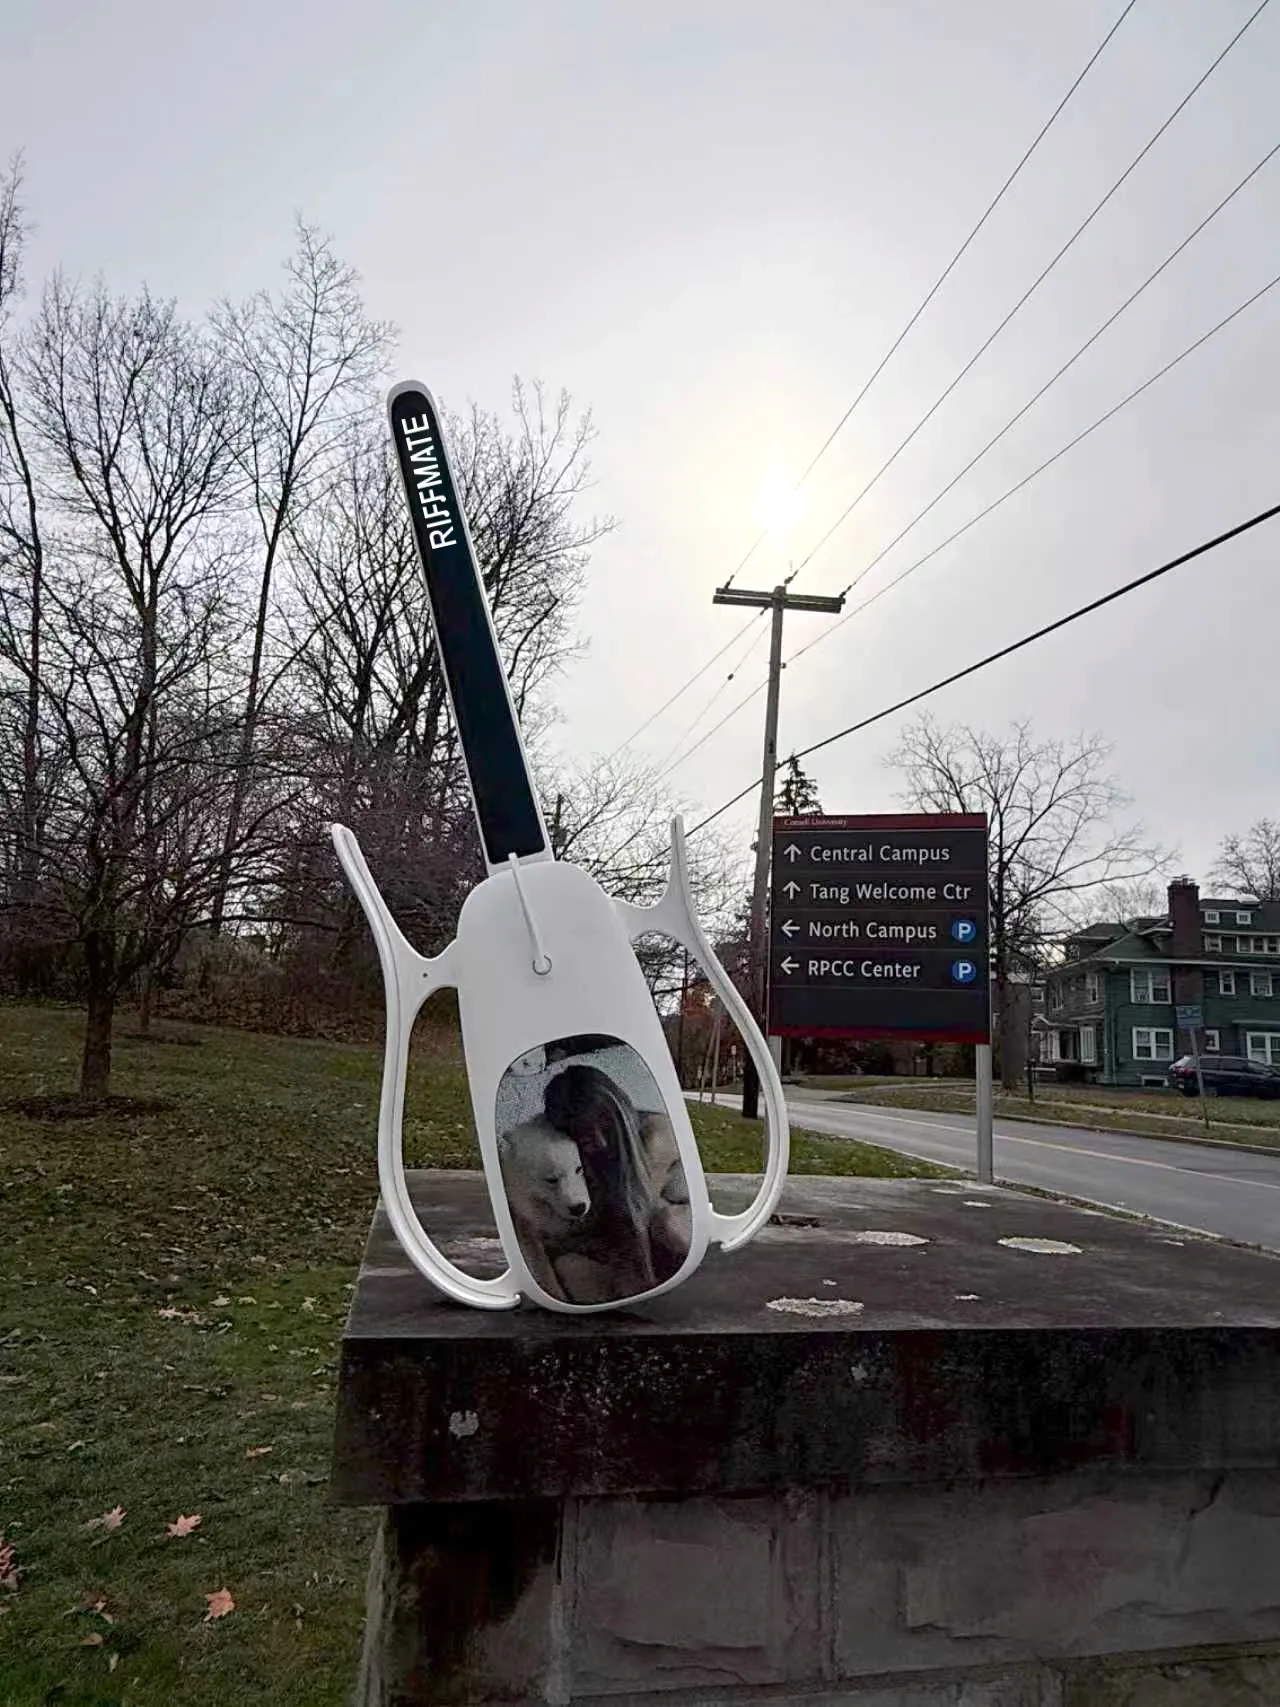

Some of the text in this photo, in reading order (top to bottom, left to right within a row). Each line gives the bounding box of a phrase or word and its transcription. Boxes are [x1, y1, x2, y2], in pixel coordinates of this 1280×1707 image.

[401, 413, 457, 549] RIFFMATE
[810, 845, 951, 865] Central Campus
[810, 882, 972, 904] Tang Welcome Ctr
[808, 921, 971, 943] North Campus P
[808, 960, 972, 979] RPCC Center P
